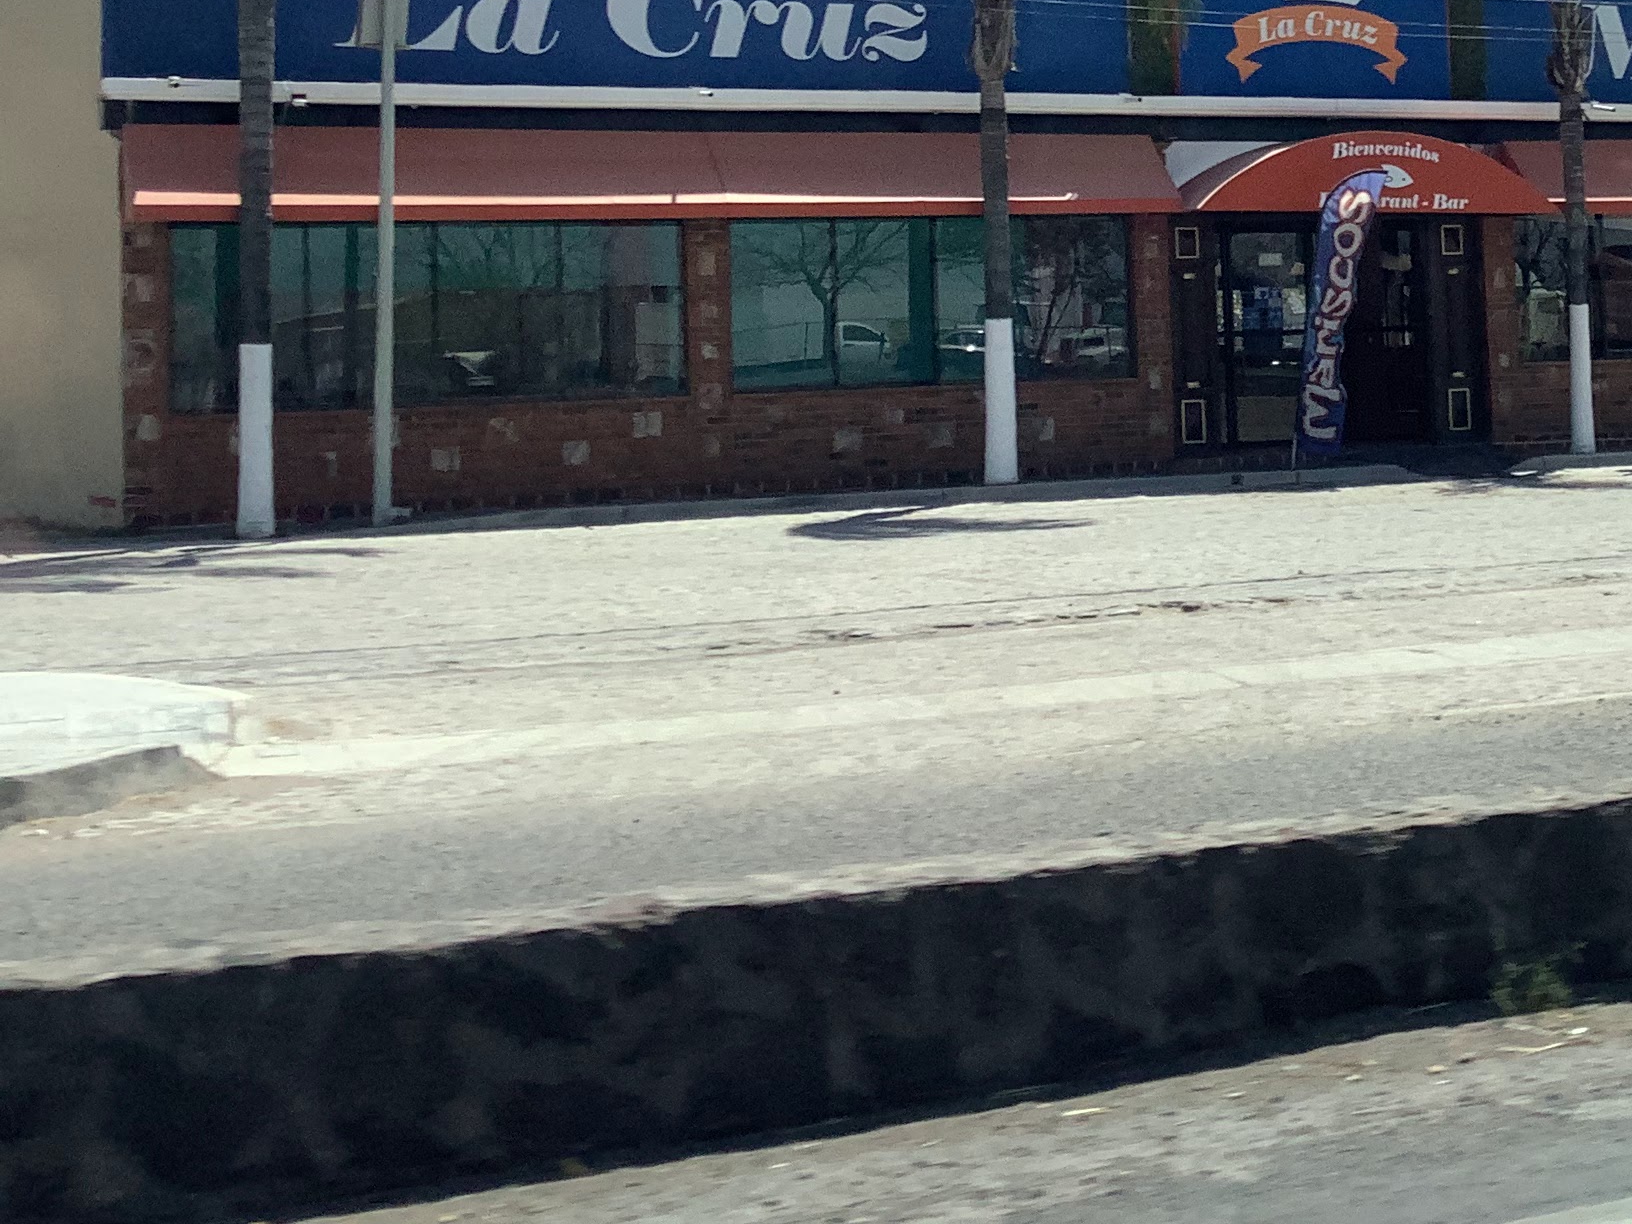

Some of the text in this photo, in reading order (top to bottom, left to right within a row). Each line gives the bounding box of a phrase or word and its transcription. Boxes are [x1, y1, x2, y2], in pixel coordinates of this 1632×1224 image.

[1257, 10, 1379, 45] La Cruz
[1332, 141, 1440, 163] Bienvenidos
[1432, 193, 1469, 210] Bar
[1302, 188, 1375, 440] Mariscos
